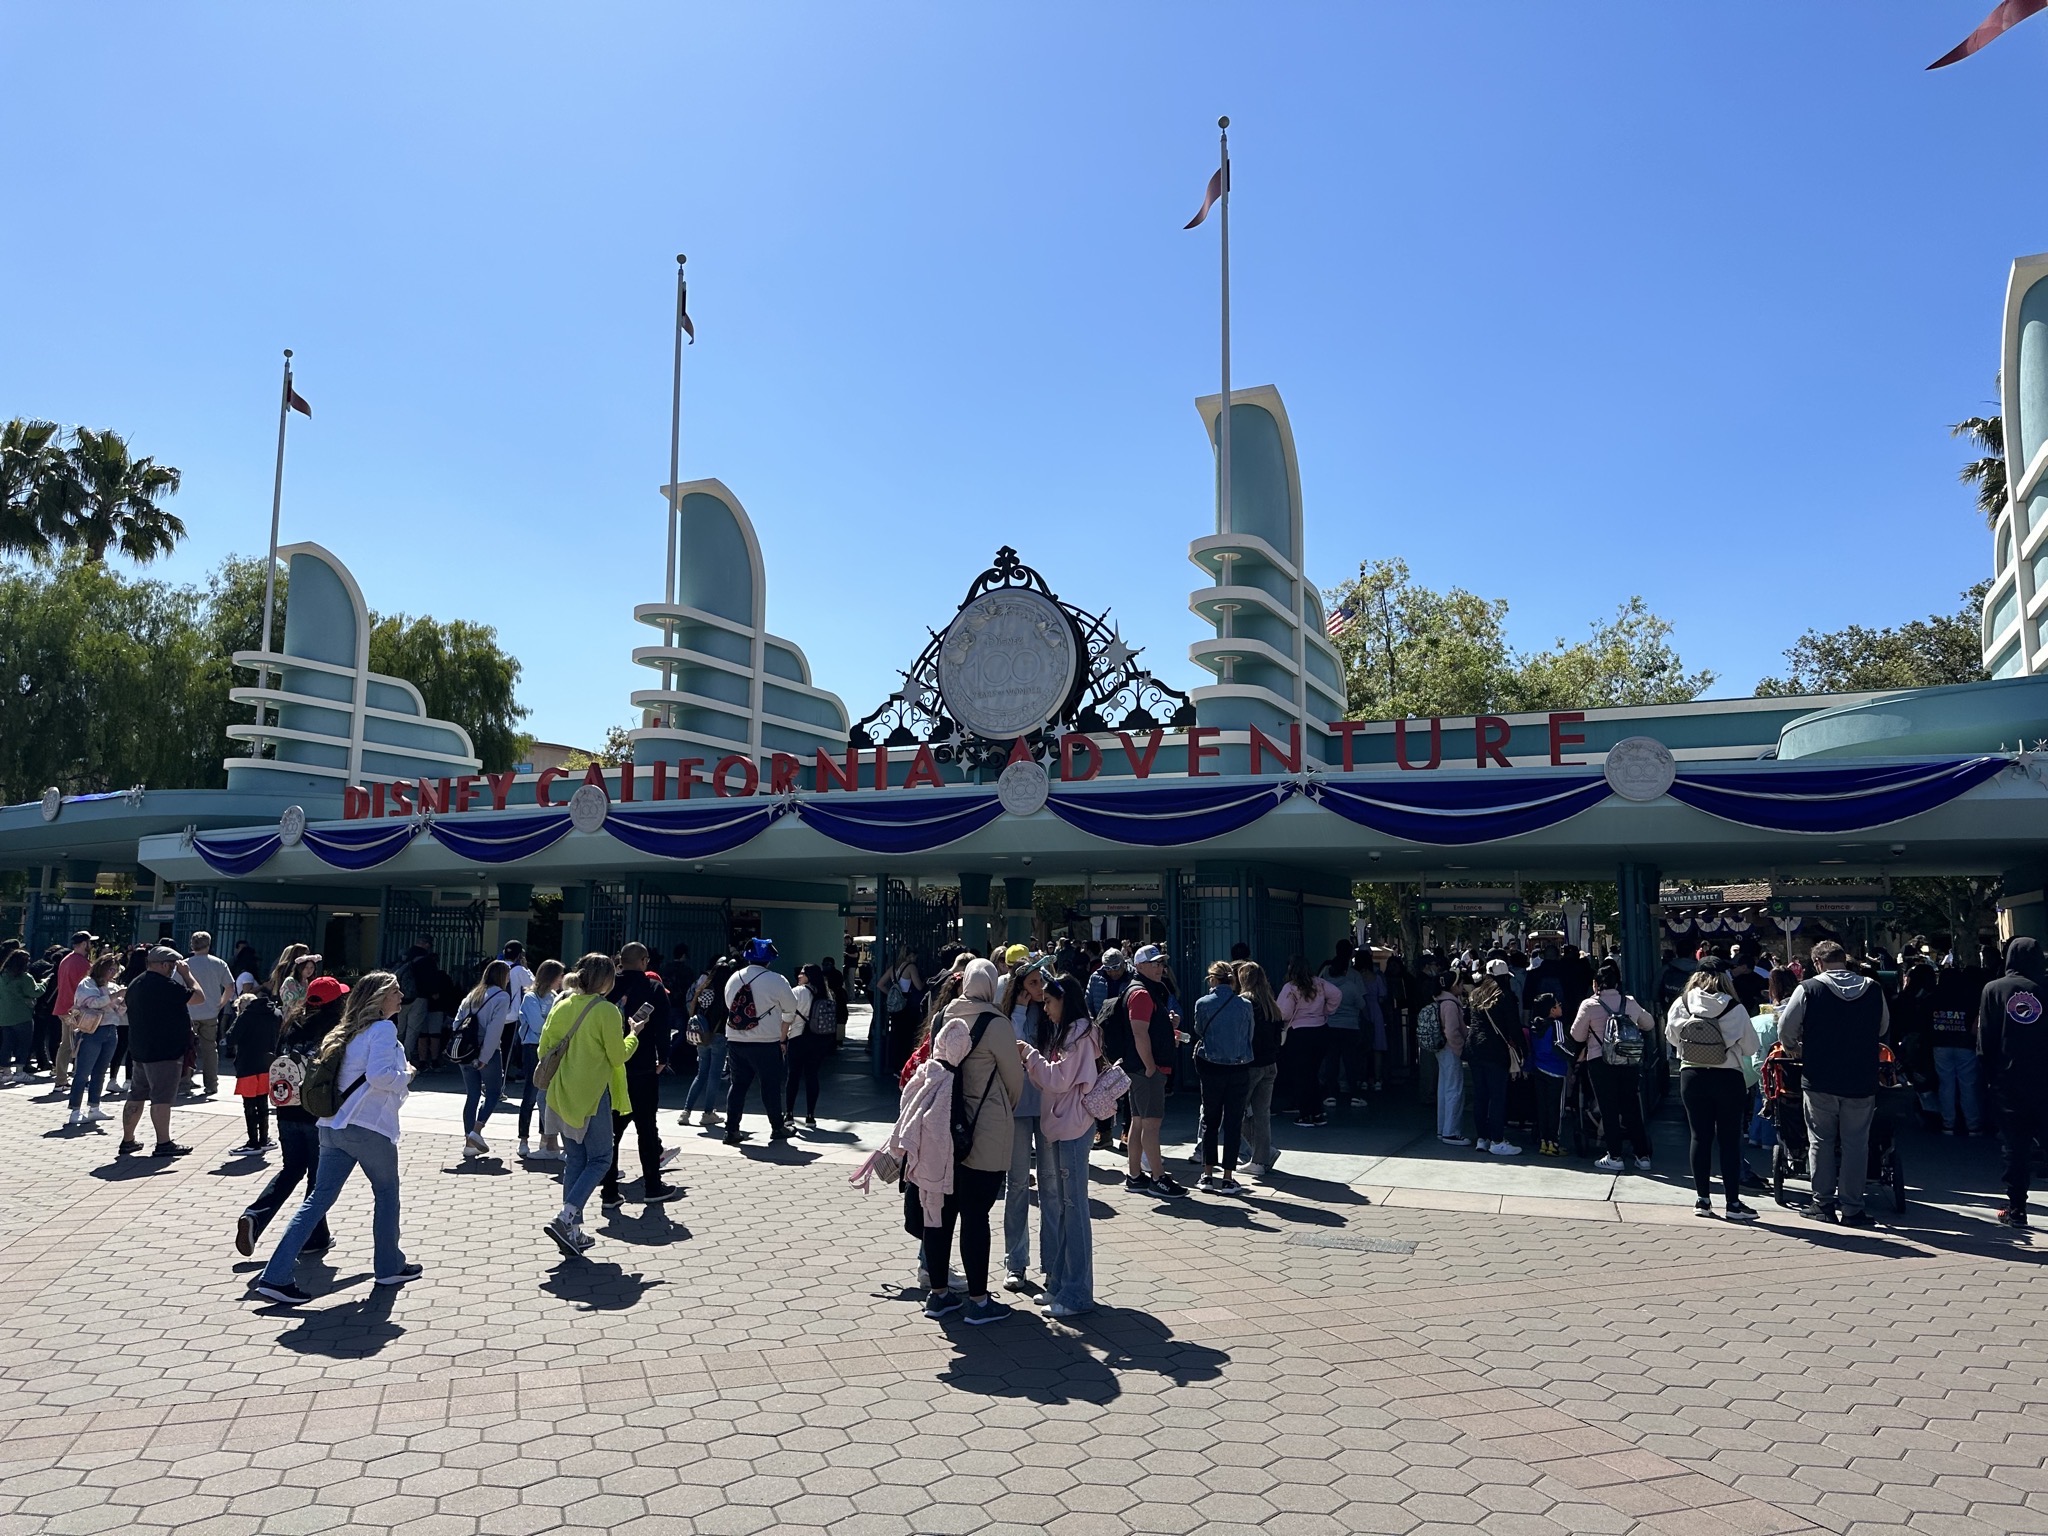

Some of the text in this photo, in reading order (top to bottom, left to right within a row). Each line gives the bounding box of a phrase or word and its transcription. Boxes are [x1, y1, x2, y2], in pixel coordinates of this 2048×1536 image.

[965, 648, 1041, 688] 100
[343, 771, 517, 820] DISNEY
[1006, 711, 1587, 782] ADVENTURE
[1693, 893, 1718, 901] STREET
[1933, 1010, 1967, 1020] GREAT
